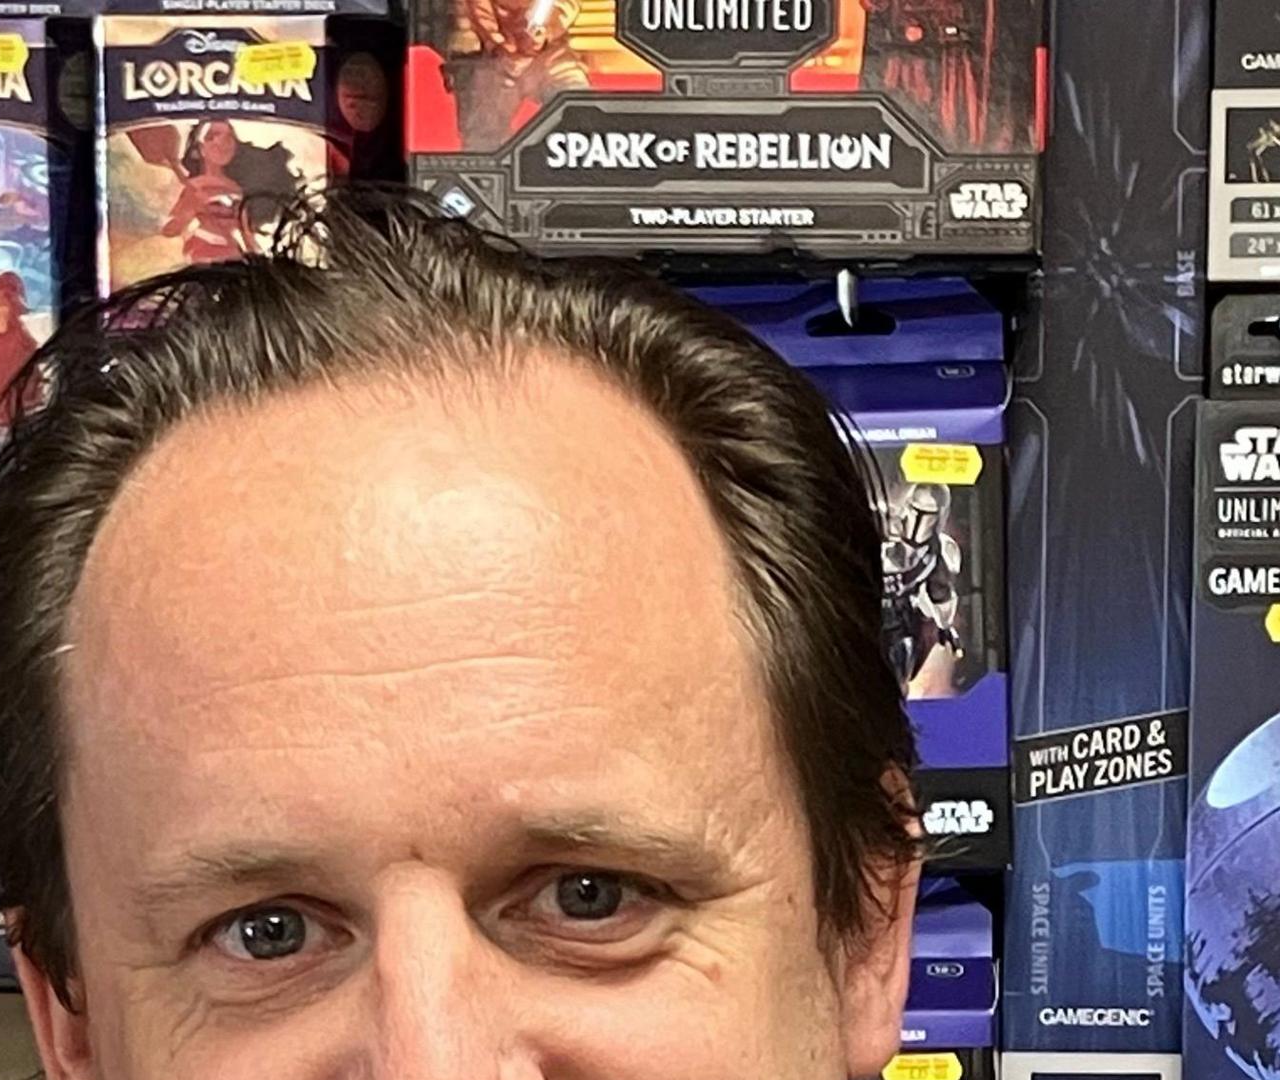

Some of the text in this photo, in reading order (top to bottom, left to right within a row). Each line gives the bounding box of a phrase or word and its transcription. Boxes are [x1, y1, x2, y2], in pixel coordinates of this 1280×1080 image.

[641, 0, 812, 31] UNLIMITED
[548, 133, 890, 169] SPARK OF REBELLION
[950, 183, 1027, 201] STAR
[630, 208, 814, 226] TWO-PLAYER STARTER
[950, 199, 1027, 219] WARS
[1252, 201, 1270, 219] 61
[1208, 567, 1280, 595] GAME
[1029, 719, 1166, 767] WITH CARD &
[1030, 749, 1172, 797] PLAY ZONES
[923, 801, 993, 819] STAR
[923, 817, 992, 834] WARS
[1031, 882, 1050, 996] SPACE UNITS
[1147, 885, 1166, 997] SPACE UNITS
[1040, 1008, 1151, 1026] GAMEGENIC
